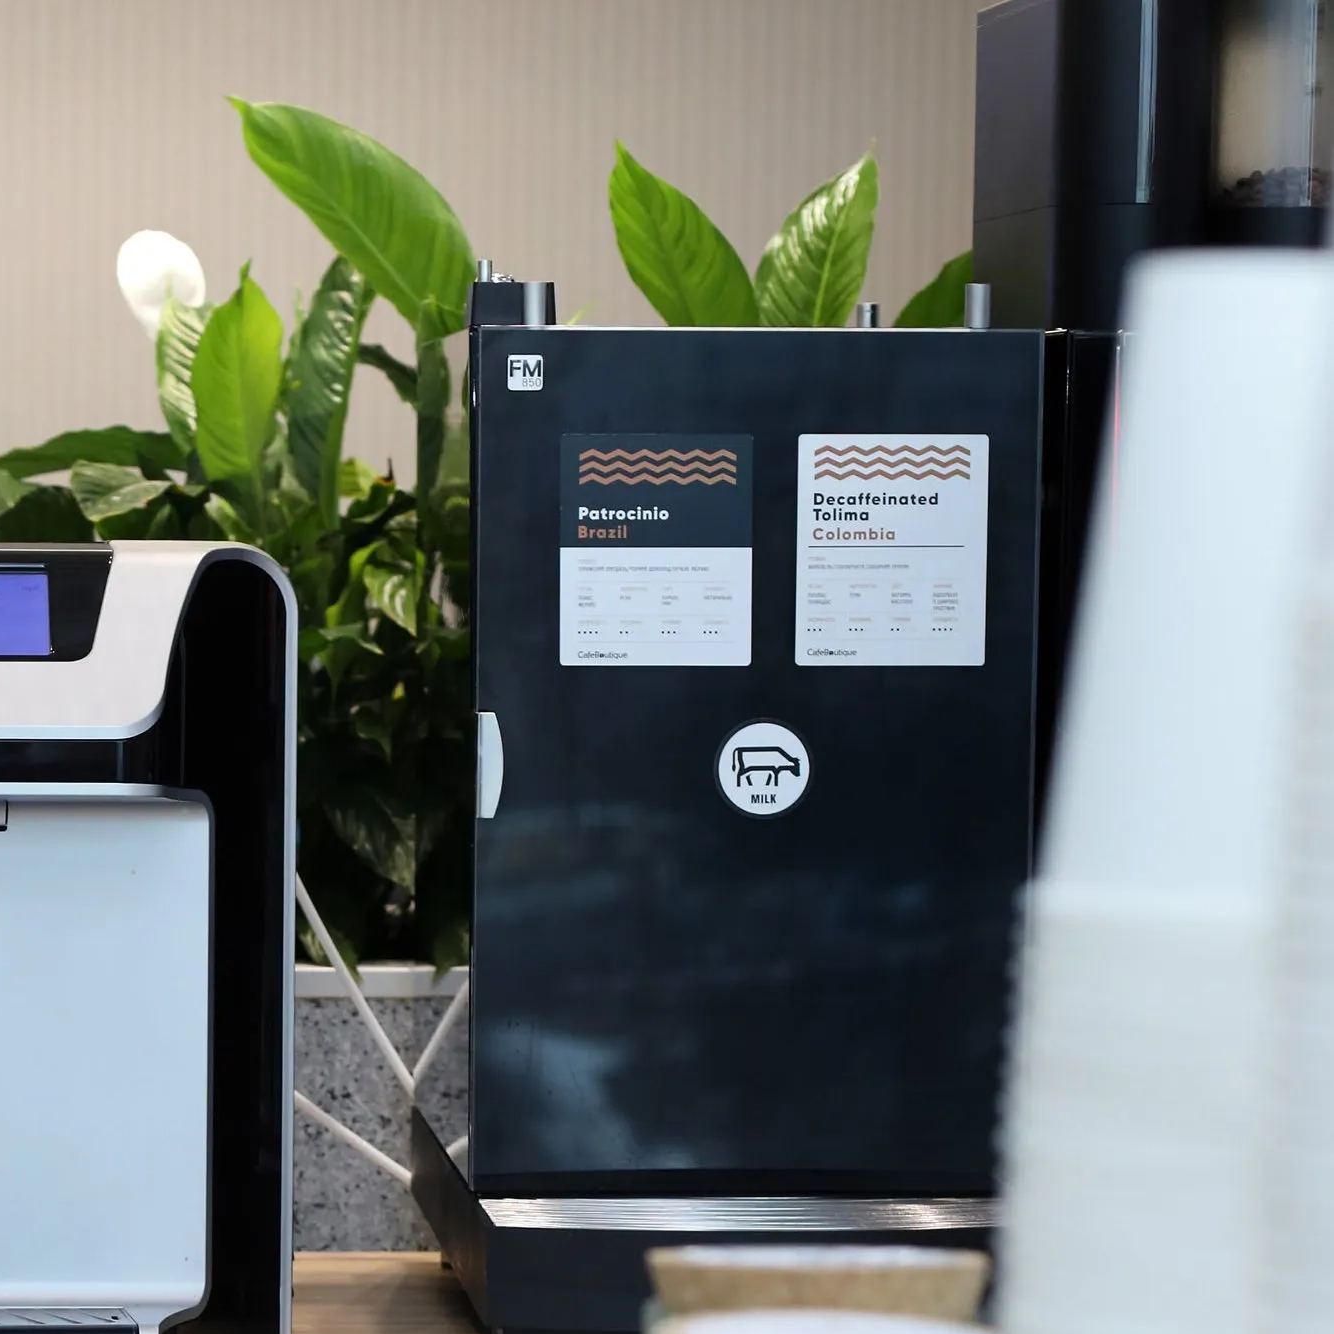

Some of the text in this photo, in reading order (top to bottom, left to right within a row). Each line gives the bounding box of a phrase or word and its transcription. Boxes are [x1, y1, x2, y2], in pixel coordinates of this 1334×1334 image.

[509, 359, 542, 378] FM
[813, 492, 939, 506] Decaffeinated
[578, 506, 670, 520] Patrocinio
[812, 508, 869, 521] Tolima
[577, 525, 627, 539] Brazil
[812, 527, 896, 540] Colombia
[751, 794, 777, 804] MILK
